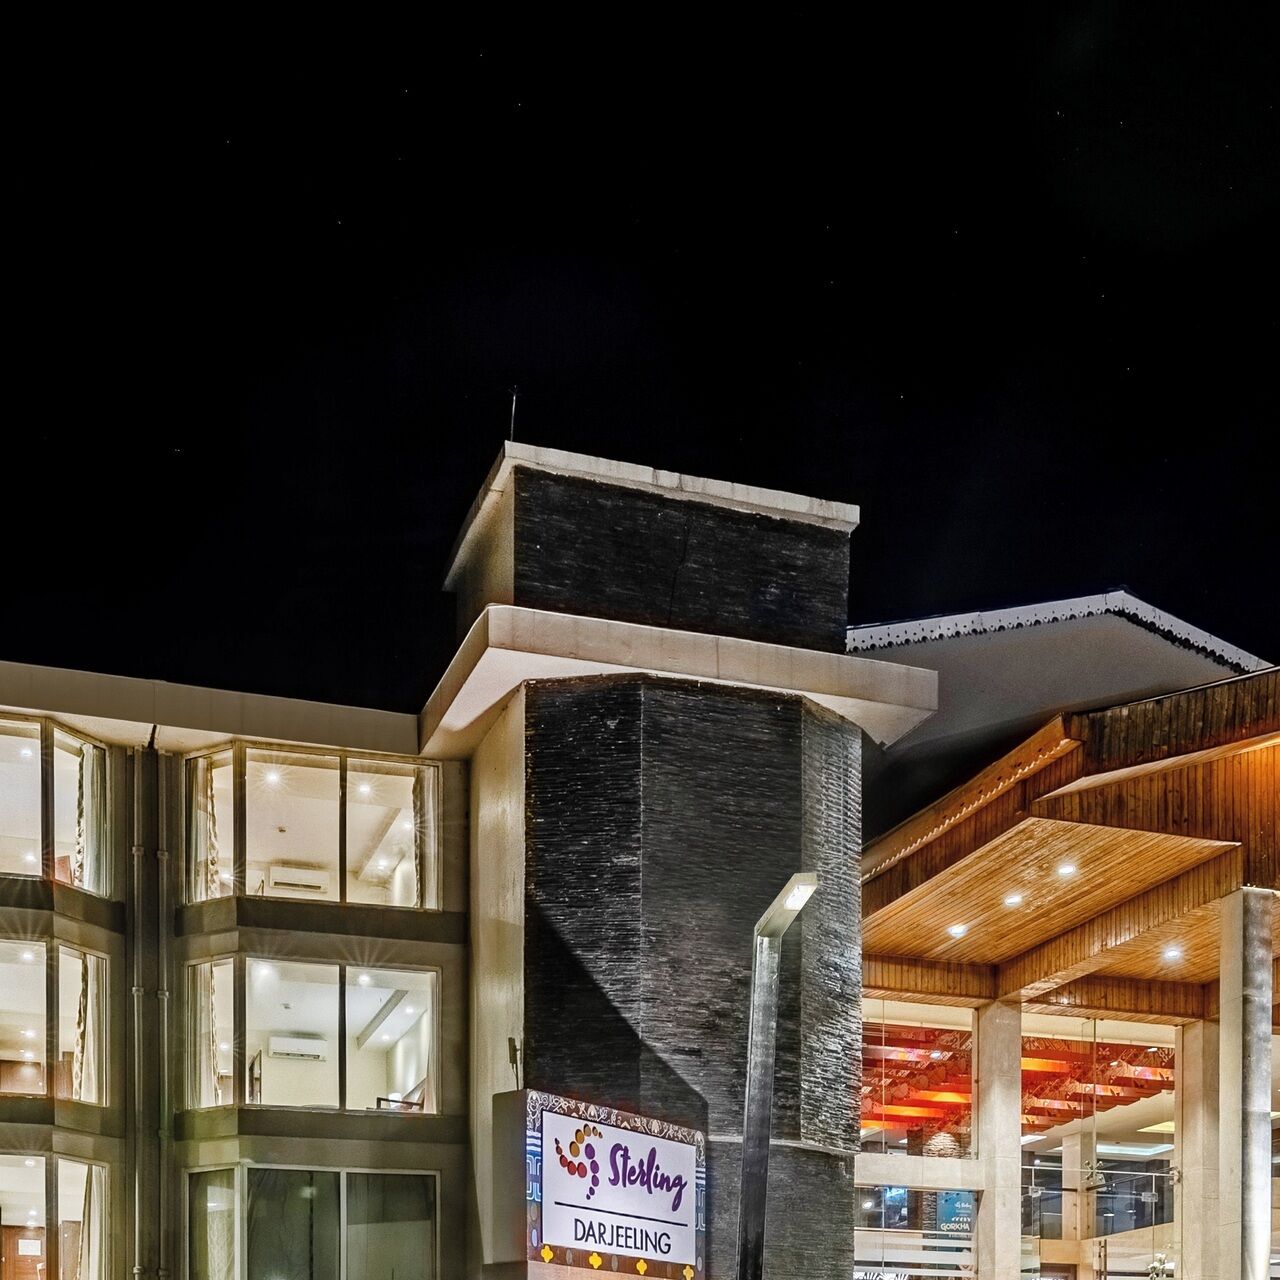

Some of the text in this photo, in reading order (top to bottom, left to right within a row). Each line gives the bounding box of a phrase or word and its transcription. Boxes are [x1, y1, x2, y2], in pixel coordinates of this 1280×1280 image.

[608, 1143, 687, 1212] Sterling
[574, 1218, 672, 1254] DARJEELING
[940, 1223, 970, 1231] GORKHA
